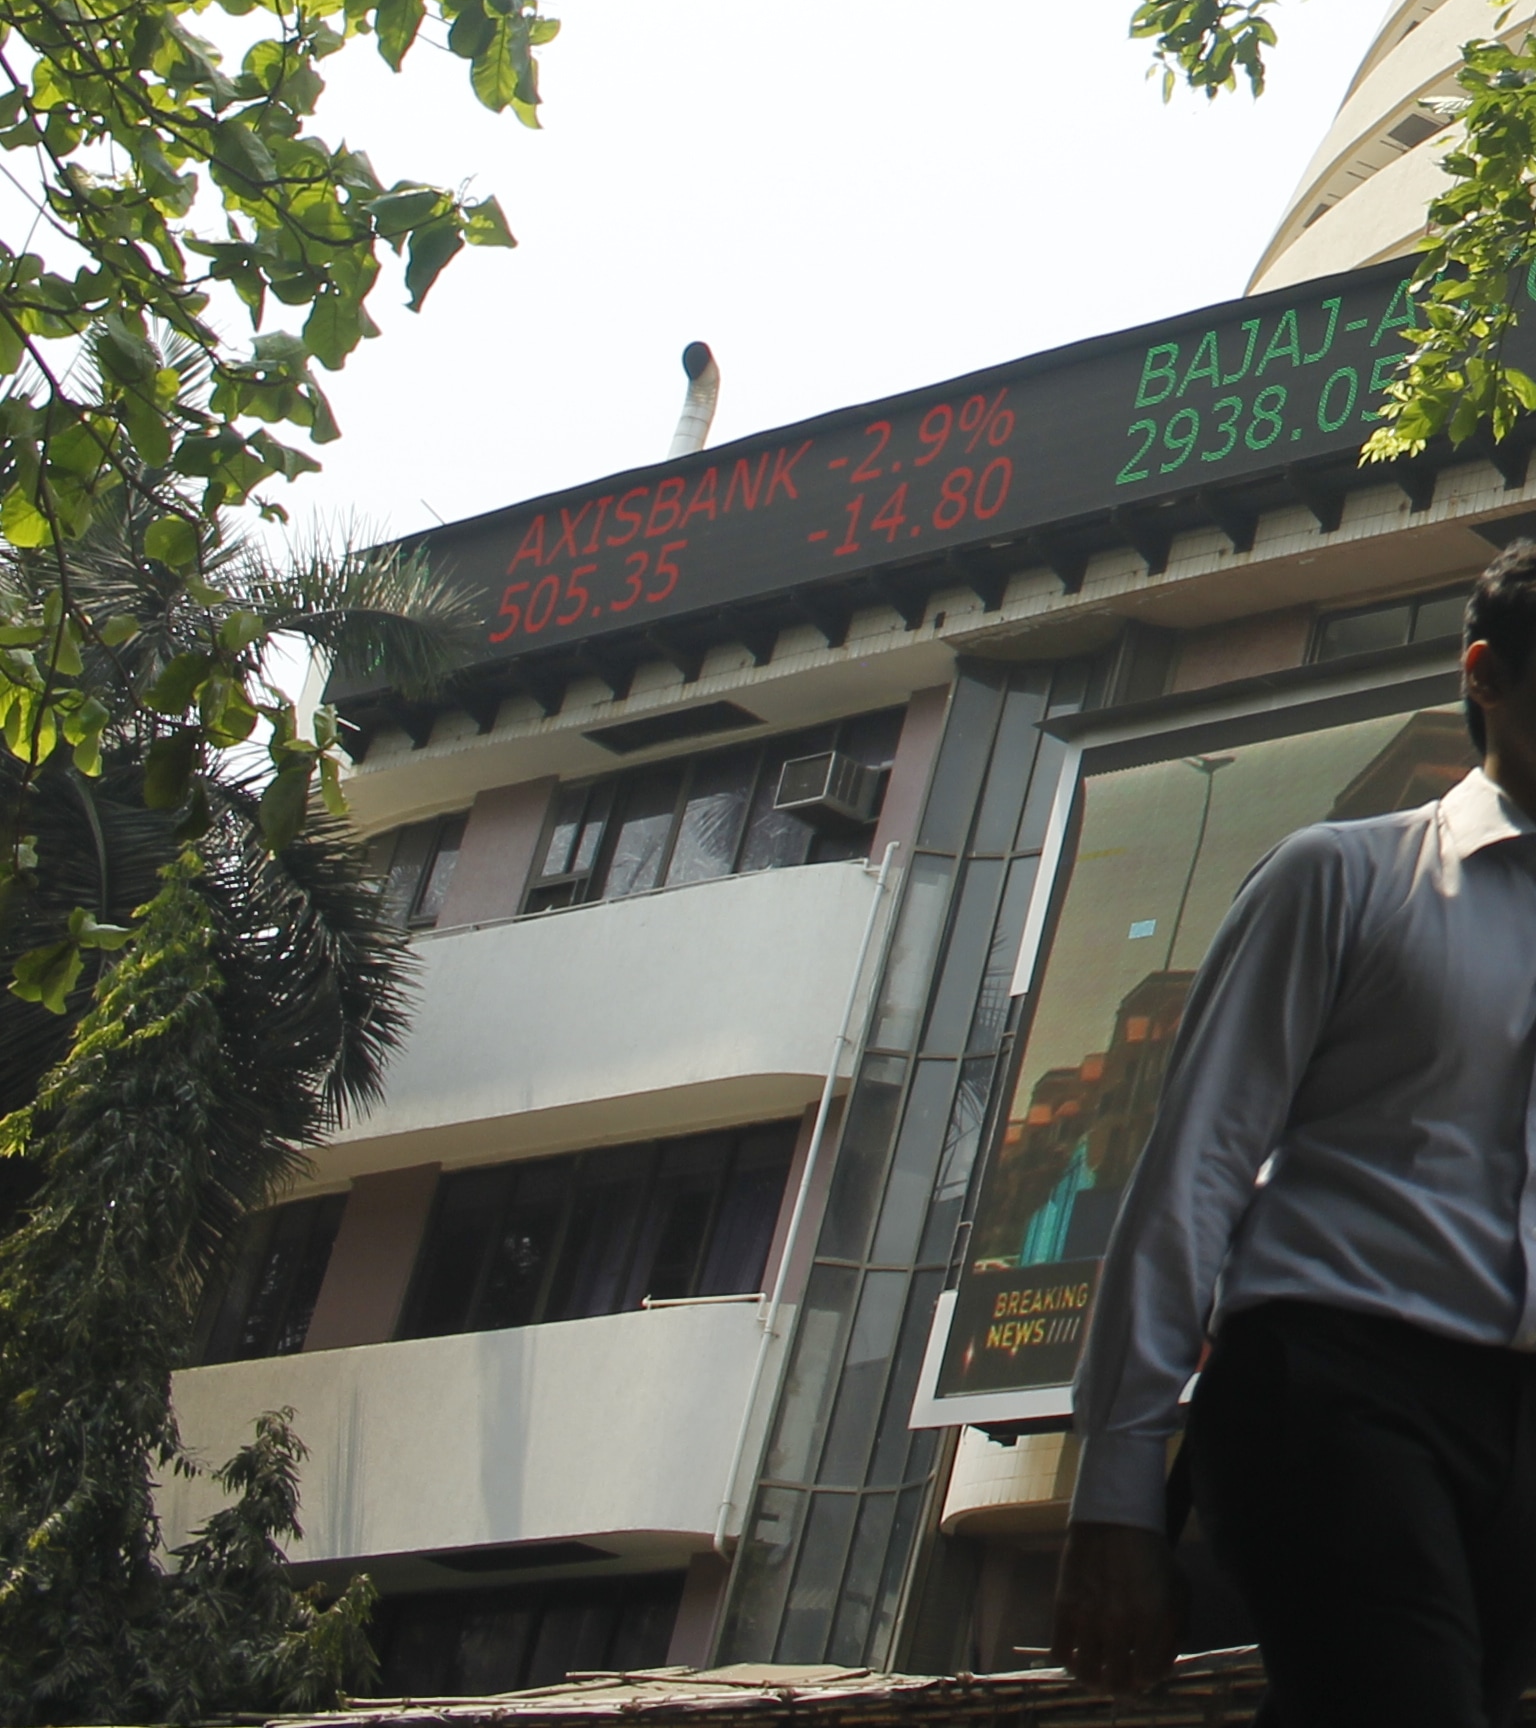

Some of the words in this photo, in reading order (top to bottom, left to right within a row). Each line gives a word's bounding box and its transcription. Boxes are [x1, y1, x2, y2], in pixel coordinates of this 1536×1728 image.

[507, 440, 814, 573] AXISBANK
[828, 388, 1016, 484] -2.9%
[1115, 352, 1410, 485] 2938.05
[489, 540, 688, 643] 505.35
[808, 456, 1014, 557] -14.80
[994, 1282, 1088, 1317] BREAKING
